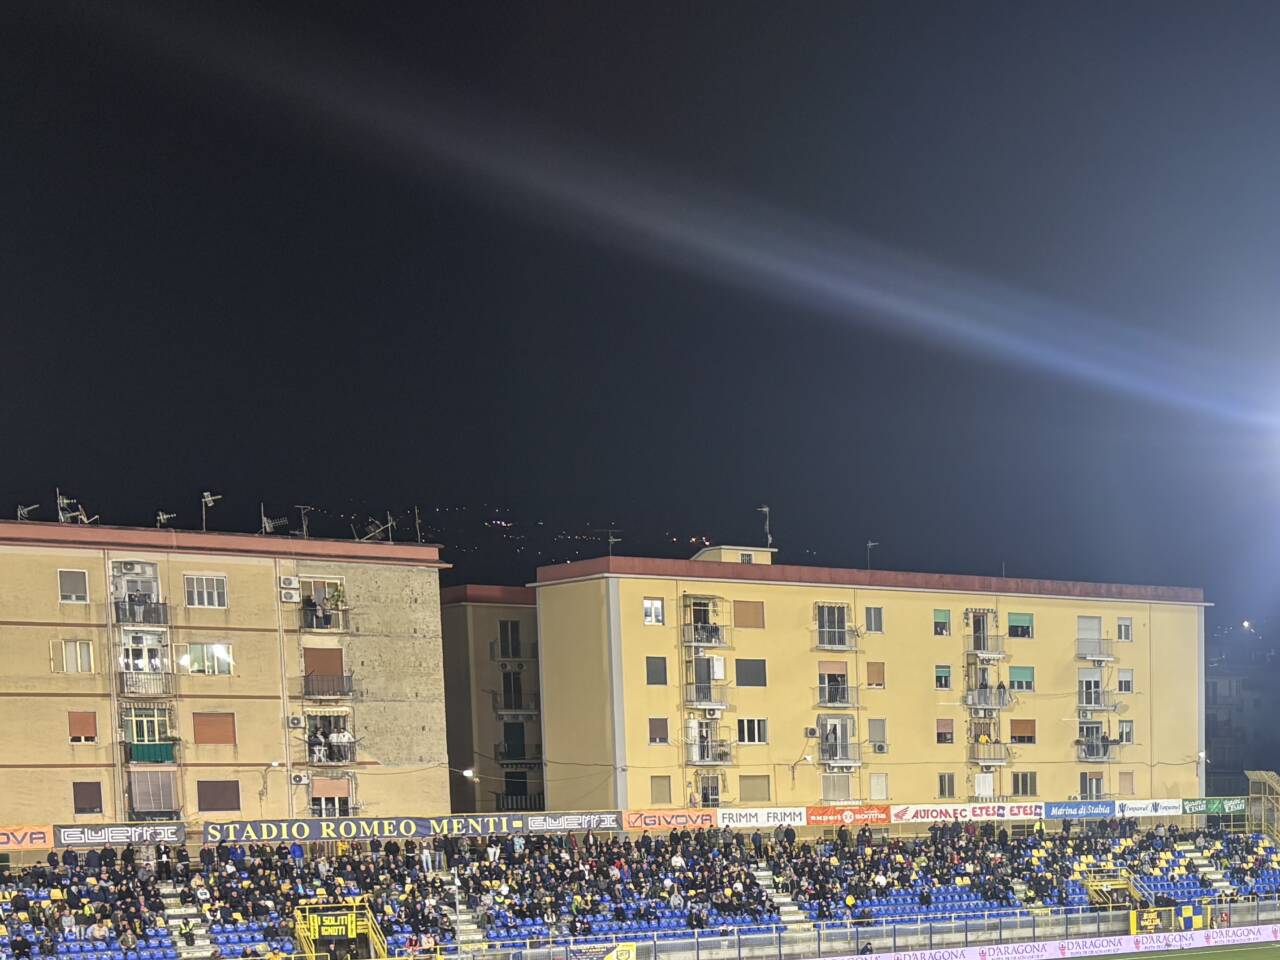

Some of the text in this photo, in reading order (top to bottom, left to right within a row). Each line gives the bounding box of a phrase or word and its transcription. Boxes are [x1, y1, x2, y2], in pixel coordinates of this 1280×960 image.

[1051, 804, 1077, 816] Marina
[1087, 802, 1110, 814] Stabia
[643, 813, 713, 827] GIVOVA
[722, 812, 758, 824] FRIMM
[767, 811, 803, 823] FRIMM
[207, 822, 310, 841] STADIO
[320, 819, 417, 838] ROMEO
[988, 943, 1047, 957] D'ARAGONA
